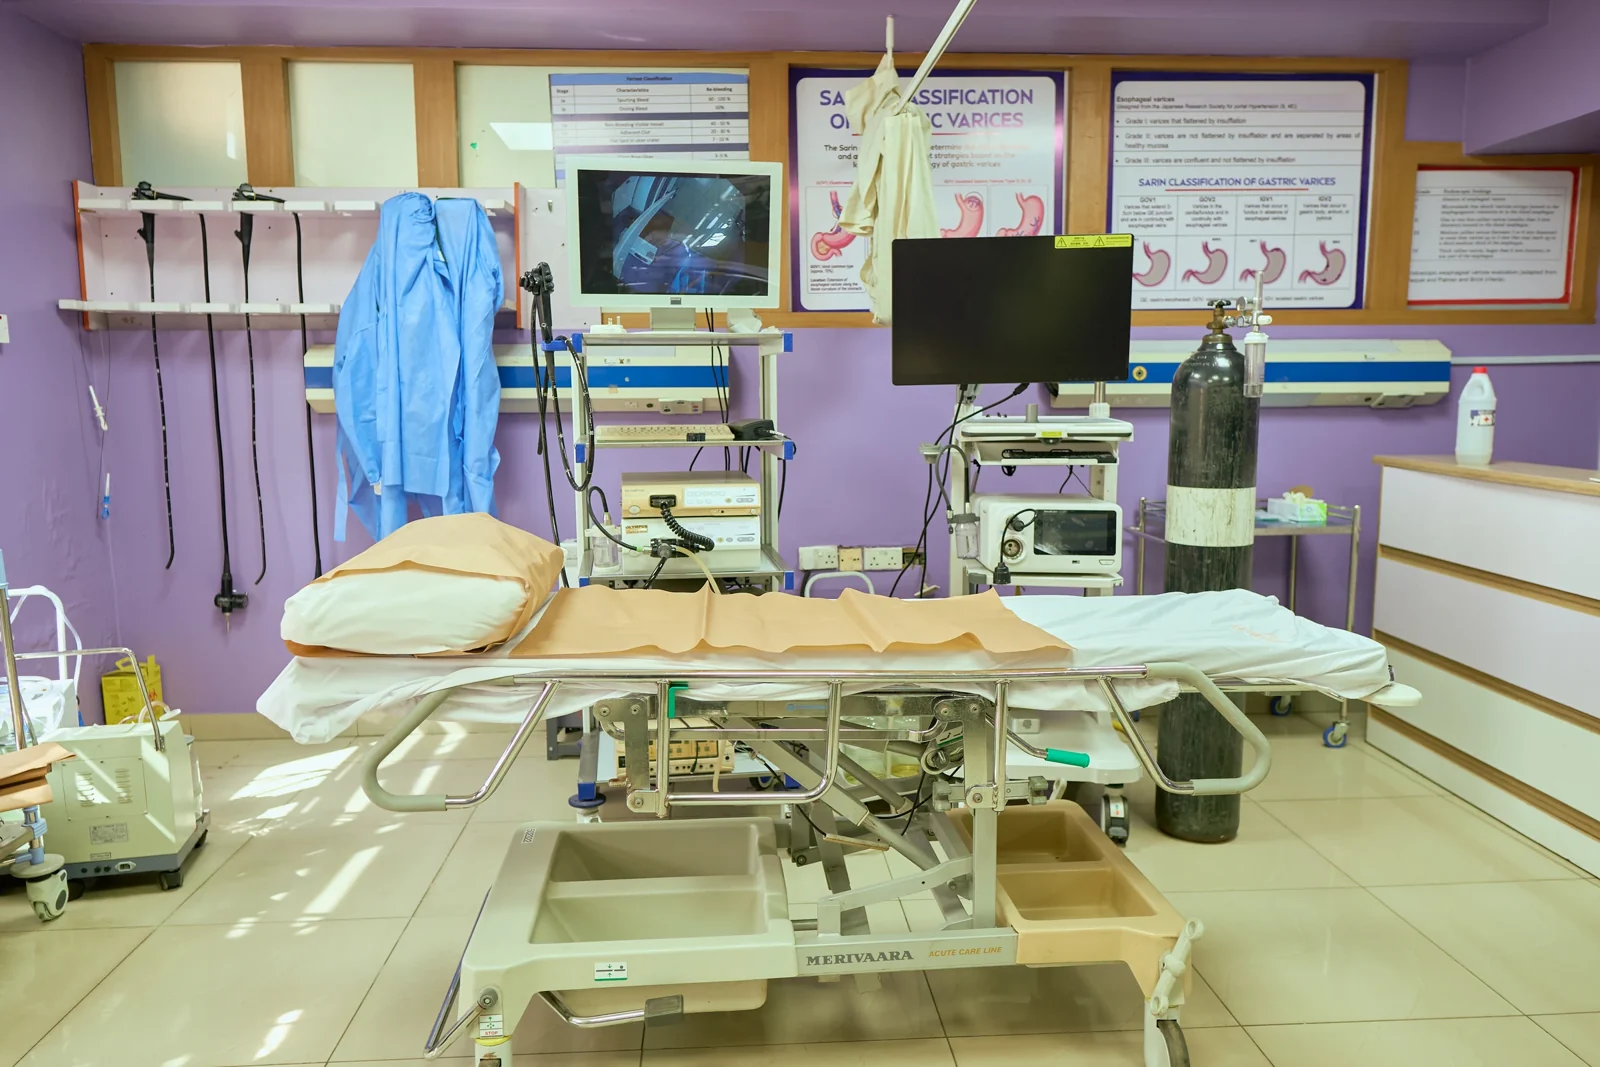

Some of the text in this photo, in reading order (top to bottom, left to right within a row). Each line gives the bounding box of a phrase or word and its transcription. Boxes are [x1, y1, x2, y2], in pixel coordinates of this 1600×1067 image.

[910, 89, 1033, 105] ASSIFICATION
[947, 113, 1024, 128] VARICES
[1168, 178, 1241, 186] CLASSIFICATION
[1300, 177, 1336, 185] VARICES
[806, 950, 914, 966] MERIVAARA
[929, 949, 956, 957] ACUTE
